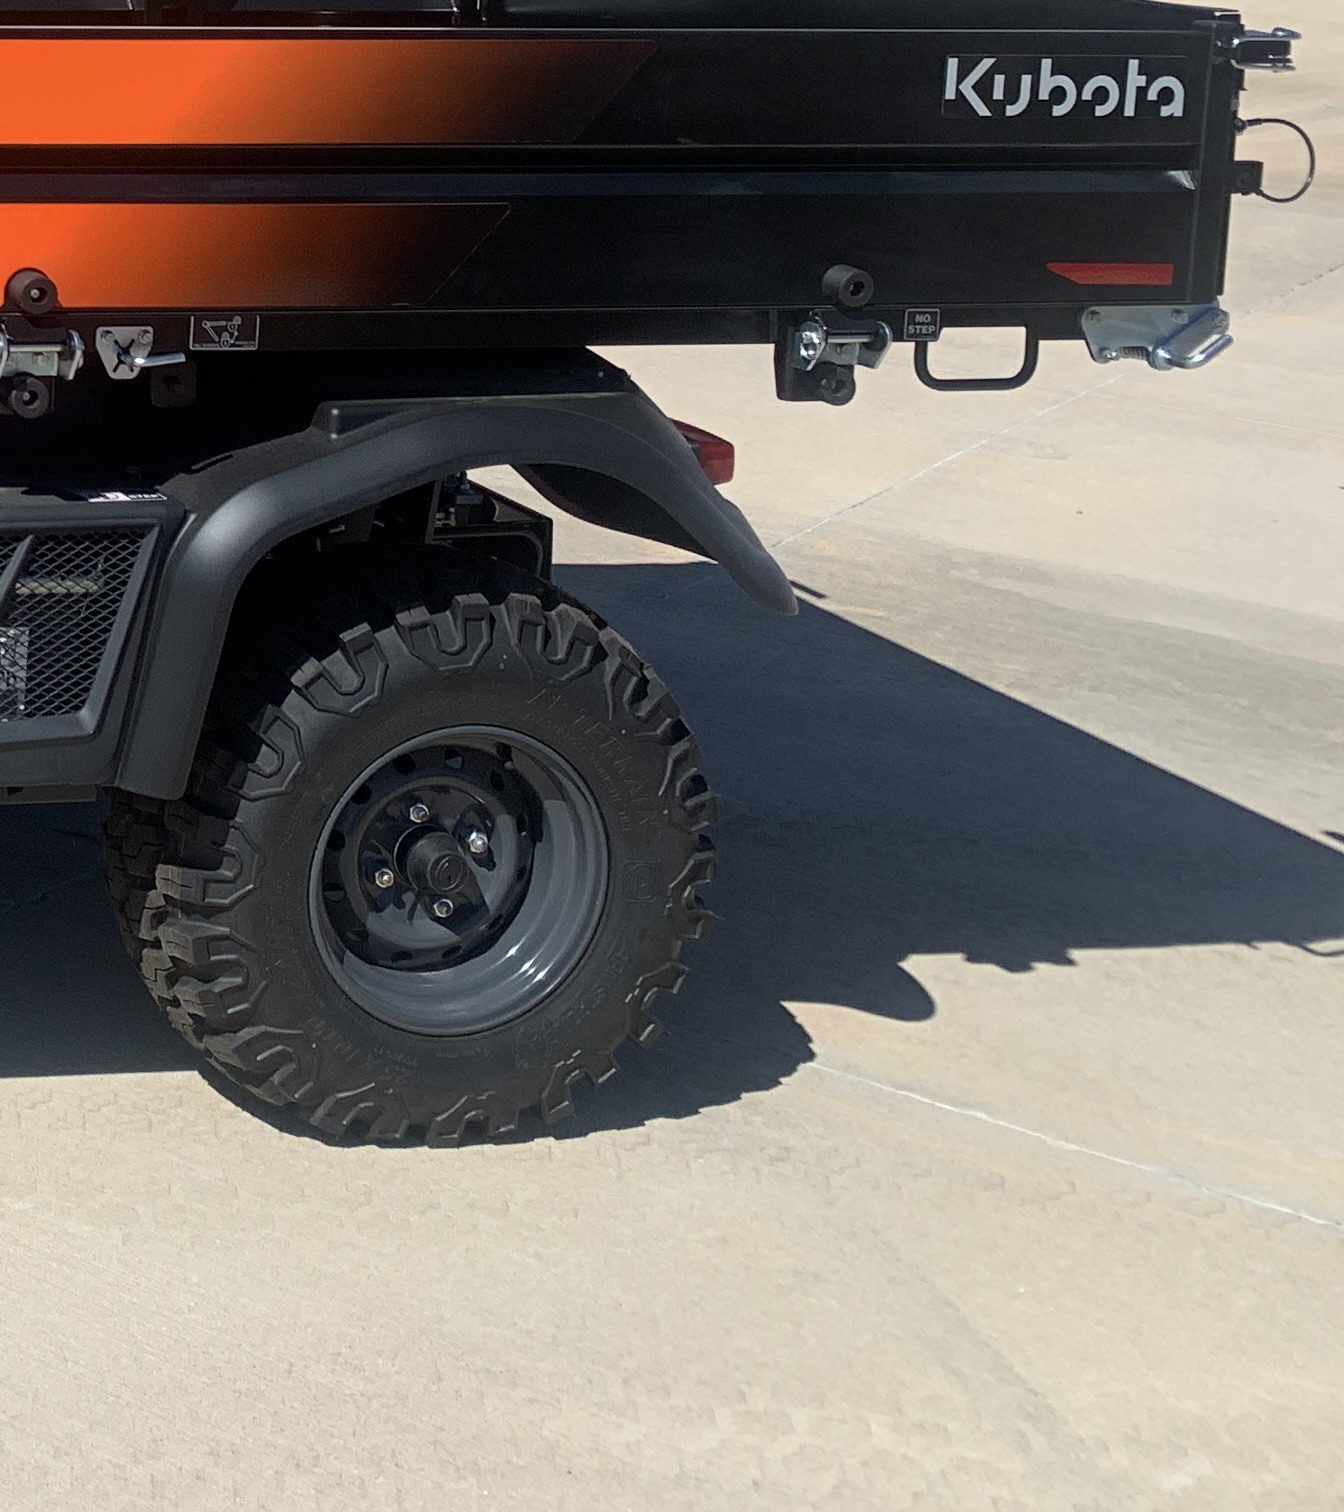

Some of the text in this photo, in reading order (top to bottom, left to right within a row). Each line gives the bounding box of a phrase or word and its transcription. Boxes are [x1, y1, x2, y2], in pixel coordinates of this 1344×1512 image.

[944, 57, 1186, 118] Kubota
[915, 314, 931, 323] NO
[908, 325, 936, 334] STEP
